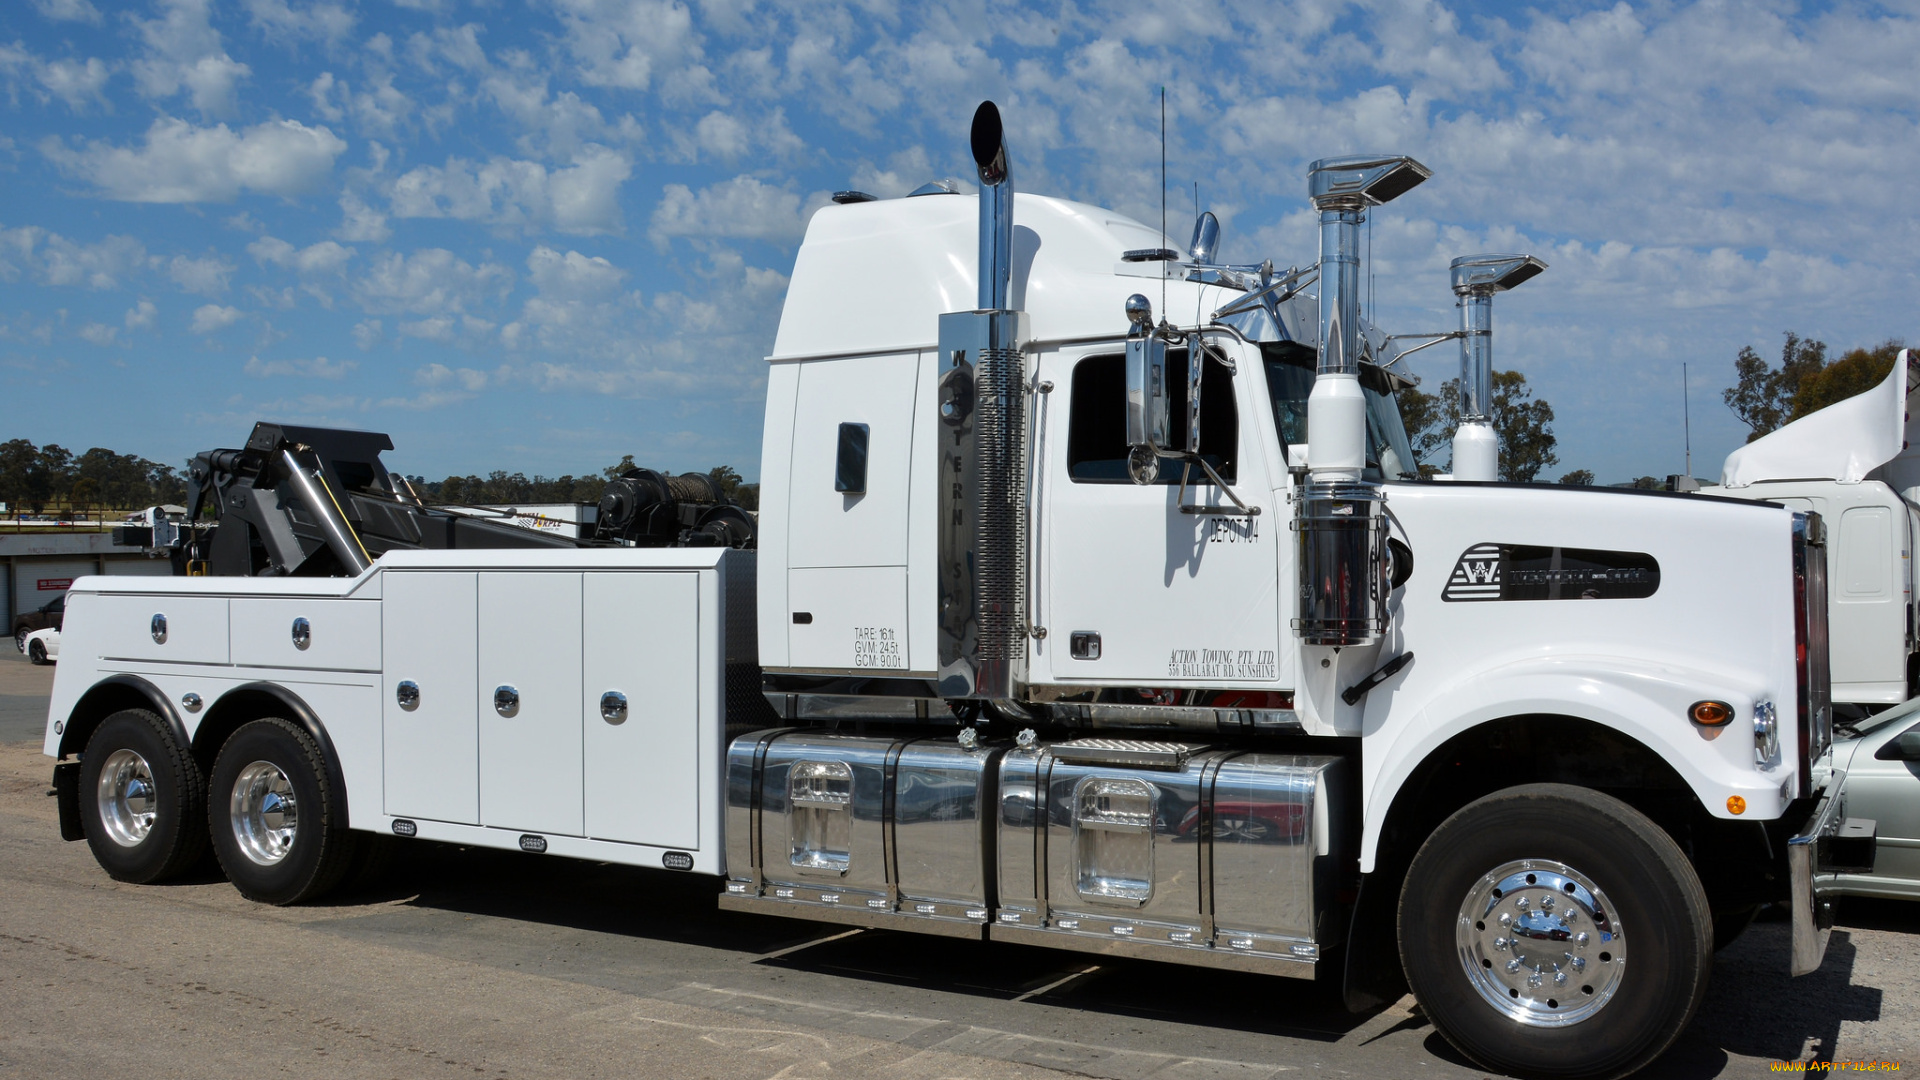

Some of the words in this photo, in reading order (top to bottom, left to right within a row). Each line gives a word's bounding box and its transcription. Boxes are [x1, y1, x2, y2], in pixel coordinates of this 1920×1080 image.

[1211, 518, 1242, 543] DEPOT
[1509, 569, 1593, 585] WESTERN
[1605, 568, 1649, 584] STAR
[855, 627, 877, 640] TARE:
[855, 641, 877, 654] GVM:
[879, 641, 899, 655] 24.5t
[855, 654, 878, 667] GCM:
[880, 654, 901, 668] 90.0t
[1169, 648, 1197, 664] ACTION
[1202, 648, 1233, 664] TOWING
[1182, 663, 1220, 677] BALLARAT
[1237, 664, 1276, 678] SUNSHINE
